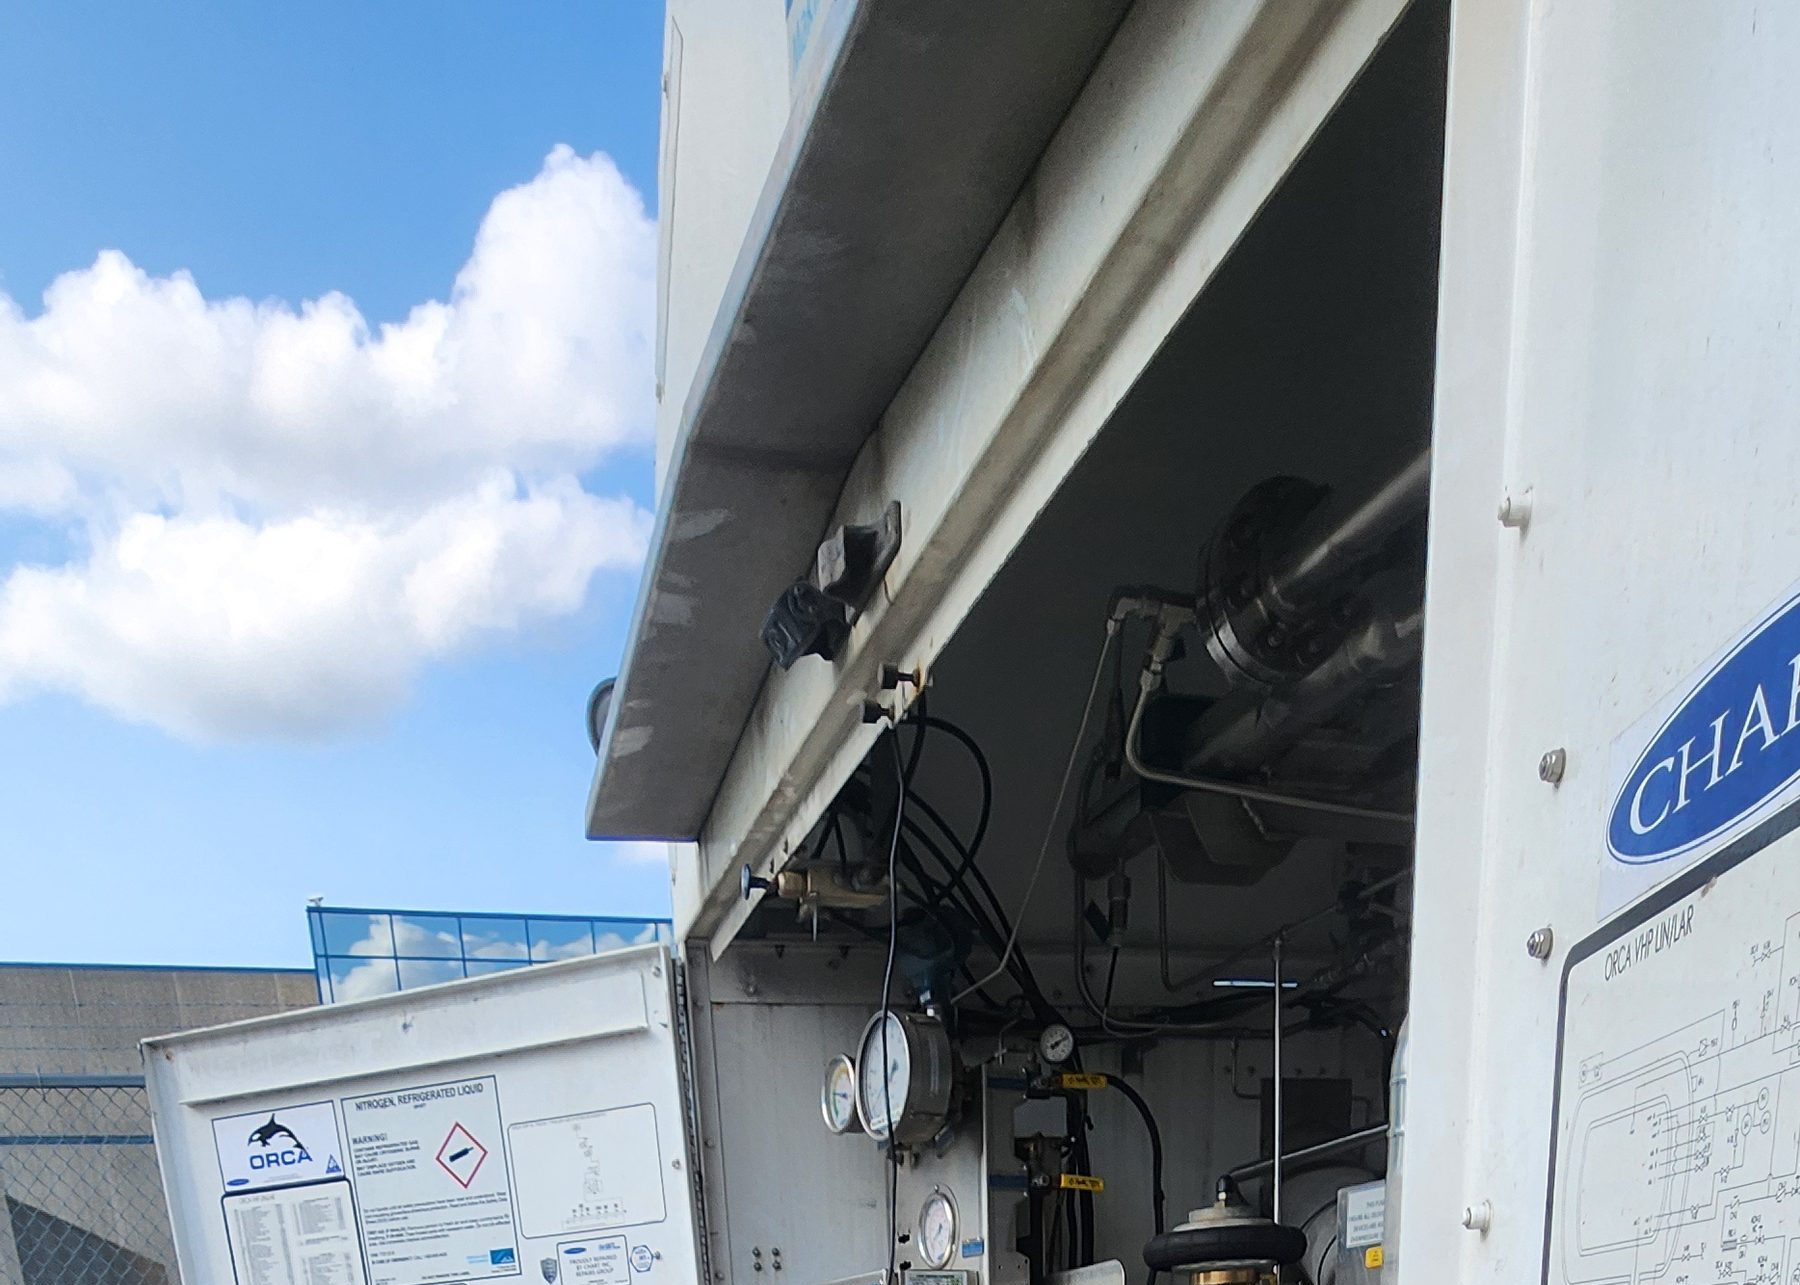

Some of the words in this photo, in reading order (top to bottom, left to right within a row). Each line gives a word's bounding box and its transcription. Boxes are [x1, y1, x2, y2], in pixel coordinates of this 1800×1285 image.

[1604, 944, 1632, 982] ORCA
[1634, 928, 1654, 964] VHP
[1654, 904, 1695, 954] LIN/LAR
[355, 1095, 396, 1112] NITROGEN,
[397, 1086, 456, 1106] REFRIGERATED
[458, 1082, 484, 1096] LIQUID
[249, 1149, 314, 1171] ORCA
